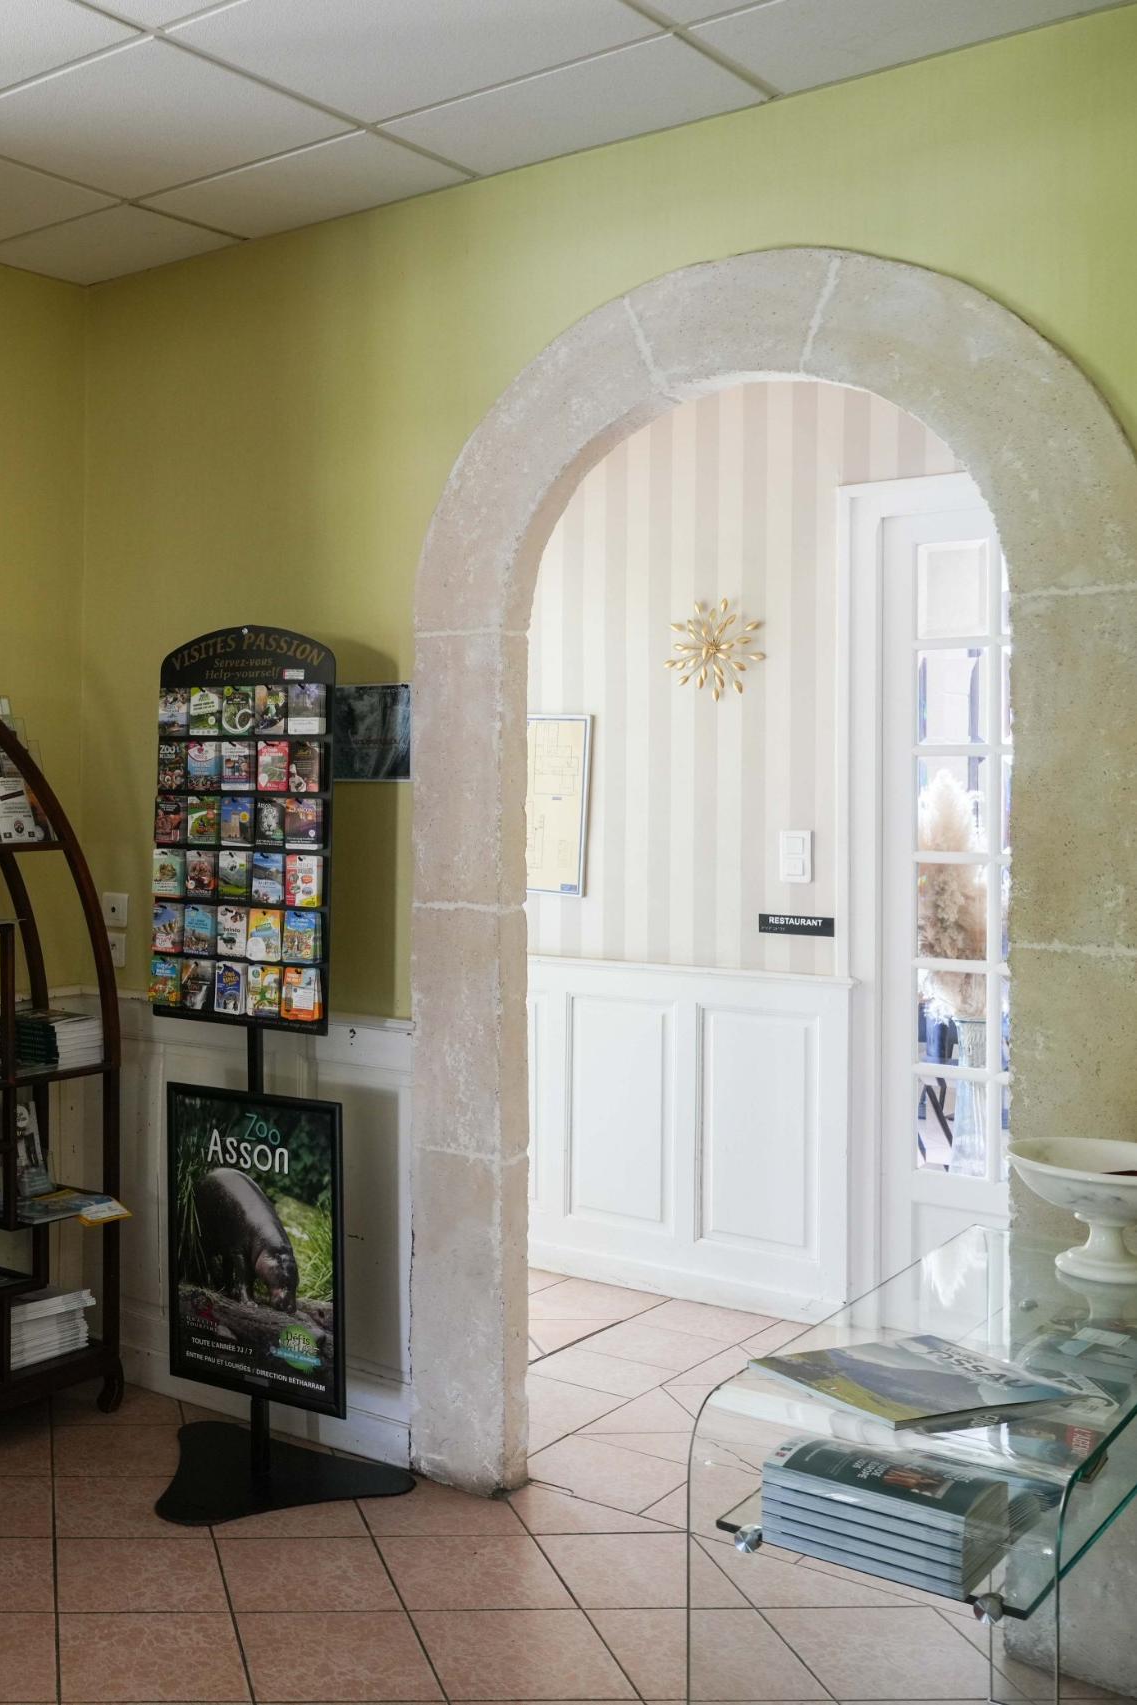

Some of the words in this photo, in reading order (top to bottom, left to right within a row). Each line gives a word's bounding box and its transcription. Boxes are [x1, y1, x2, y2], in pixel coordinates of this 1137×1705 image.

[171, 634, 236, 671] VISITES
[242, 632, 326, 666] PASSION
[213, 657, 273, 669] Servez-vous
[205, 667, 280, 681] Help-yourself
[768, 916, 823, 927] RESTAURANT
[244, 1113, 281, 1146] Zoo
[191, 1336, 211, 1347] TOUTE
[185, 1350, 204, 1361] ENTRE
[204, 1354, 216, 1363] PAU
[216, 1357, 225, 1365] ET
[224, 1360, 251, 1373] LOURDES
[256, 1368, 288, 1382] DIRECTION
[288, 1375, 326, 1392] BÉTHARRAM
